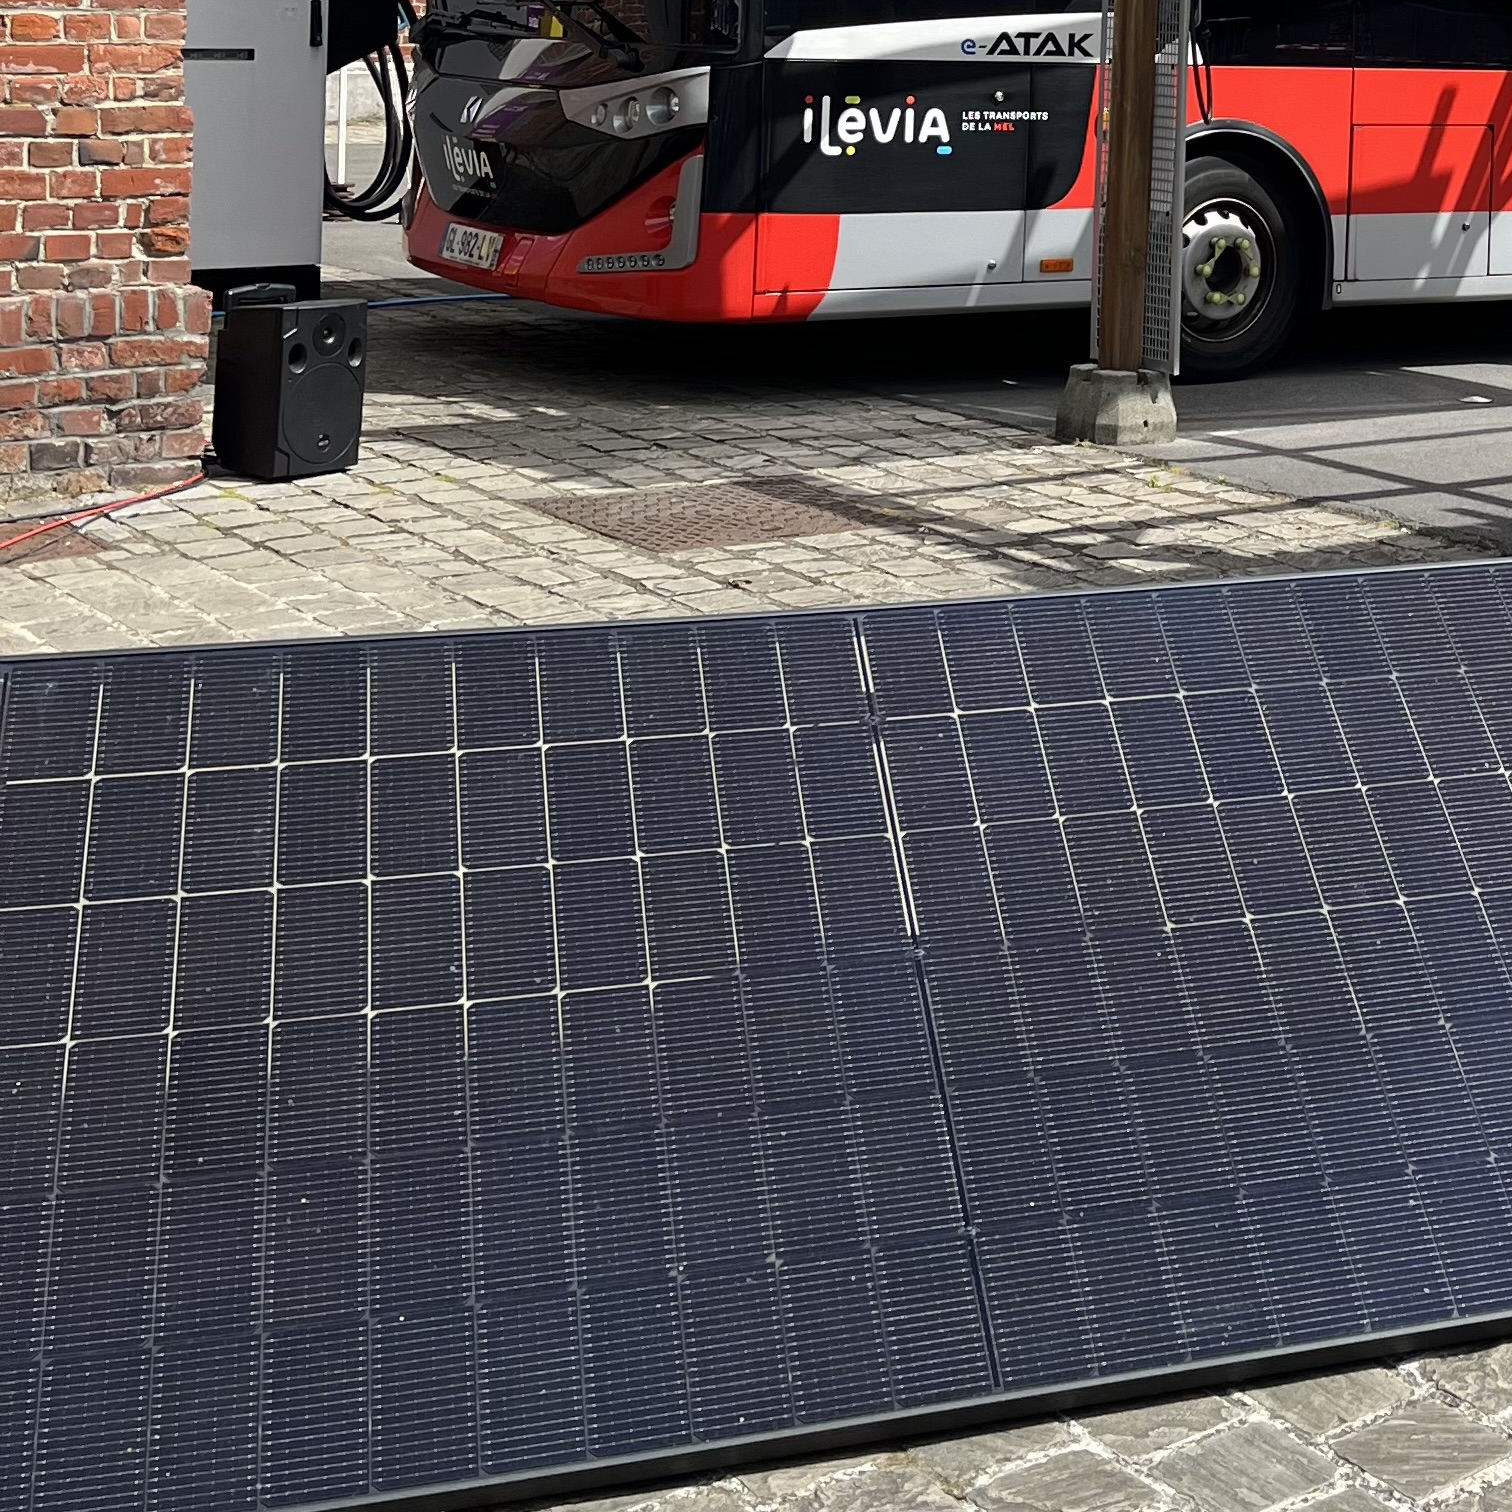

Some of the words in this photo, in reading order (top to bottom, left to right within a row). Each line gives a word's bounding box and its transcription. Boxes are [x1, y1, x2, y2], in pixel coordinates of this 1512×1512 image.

[960, 30, 1095, 58] e-ATAK
[962, 111, 981, 120] LES
[982, 111, 1049, 121] TRANSPORTS
[961, 122, 976, 131] DE
[978, 122, 992, 131] LA
[993, 122, 1015, 131] MEL
